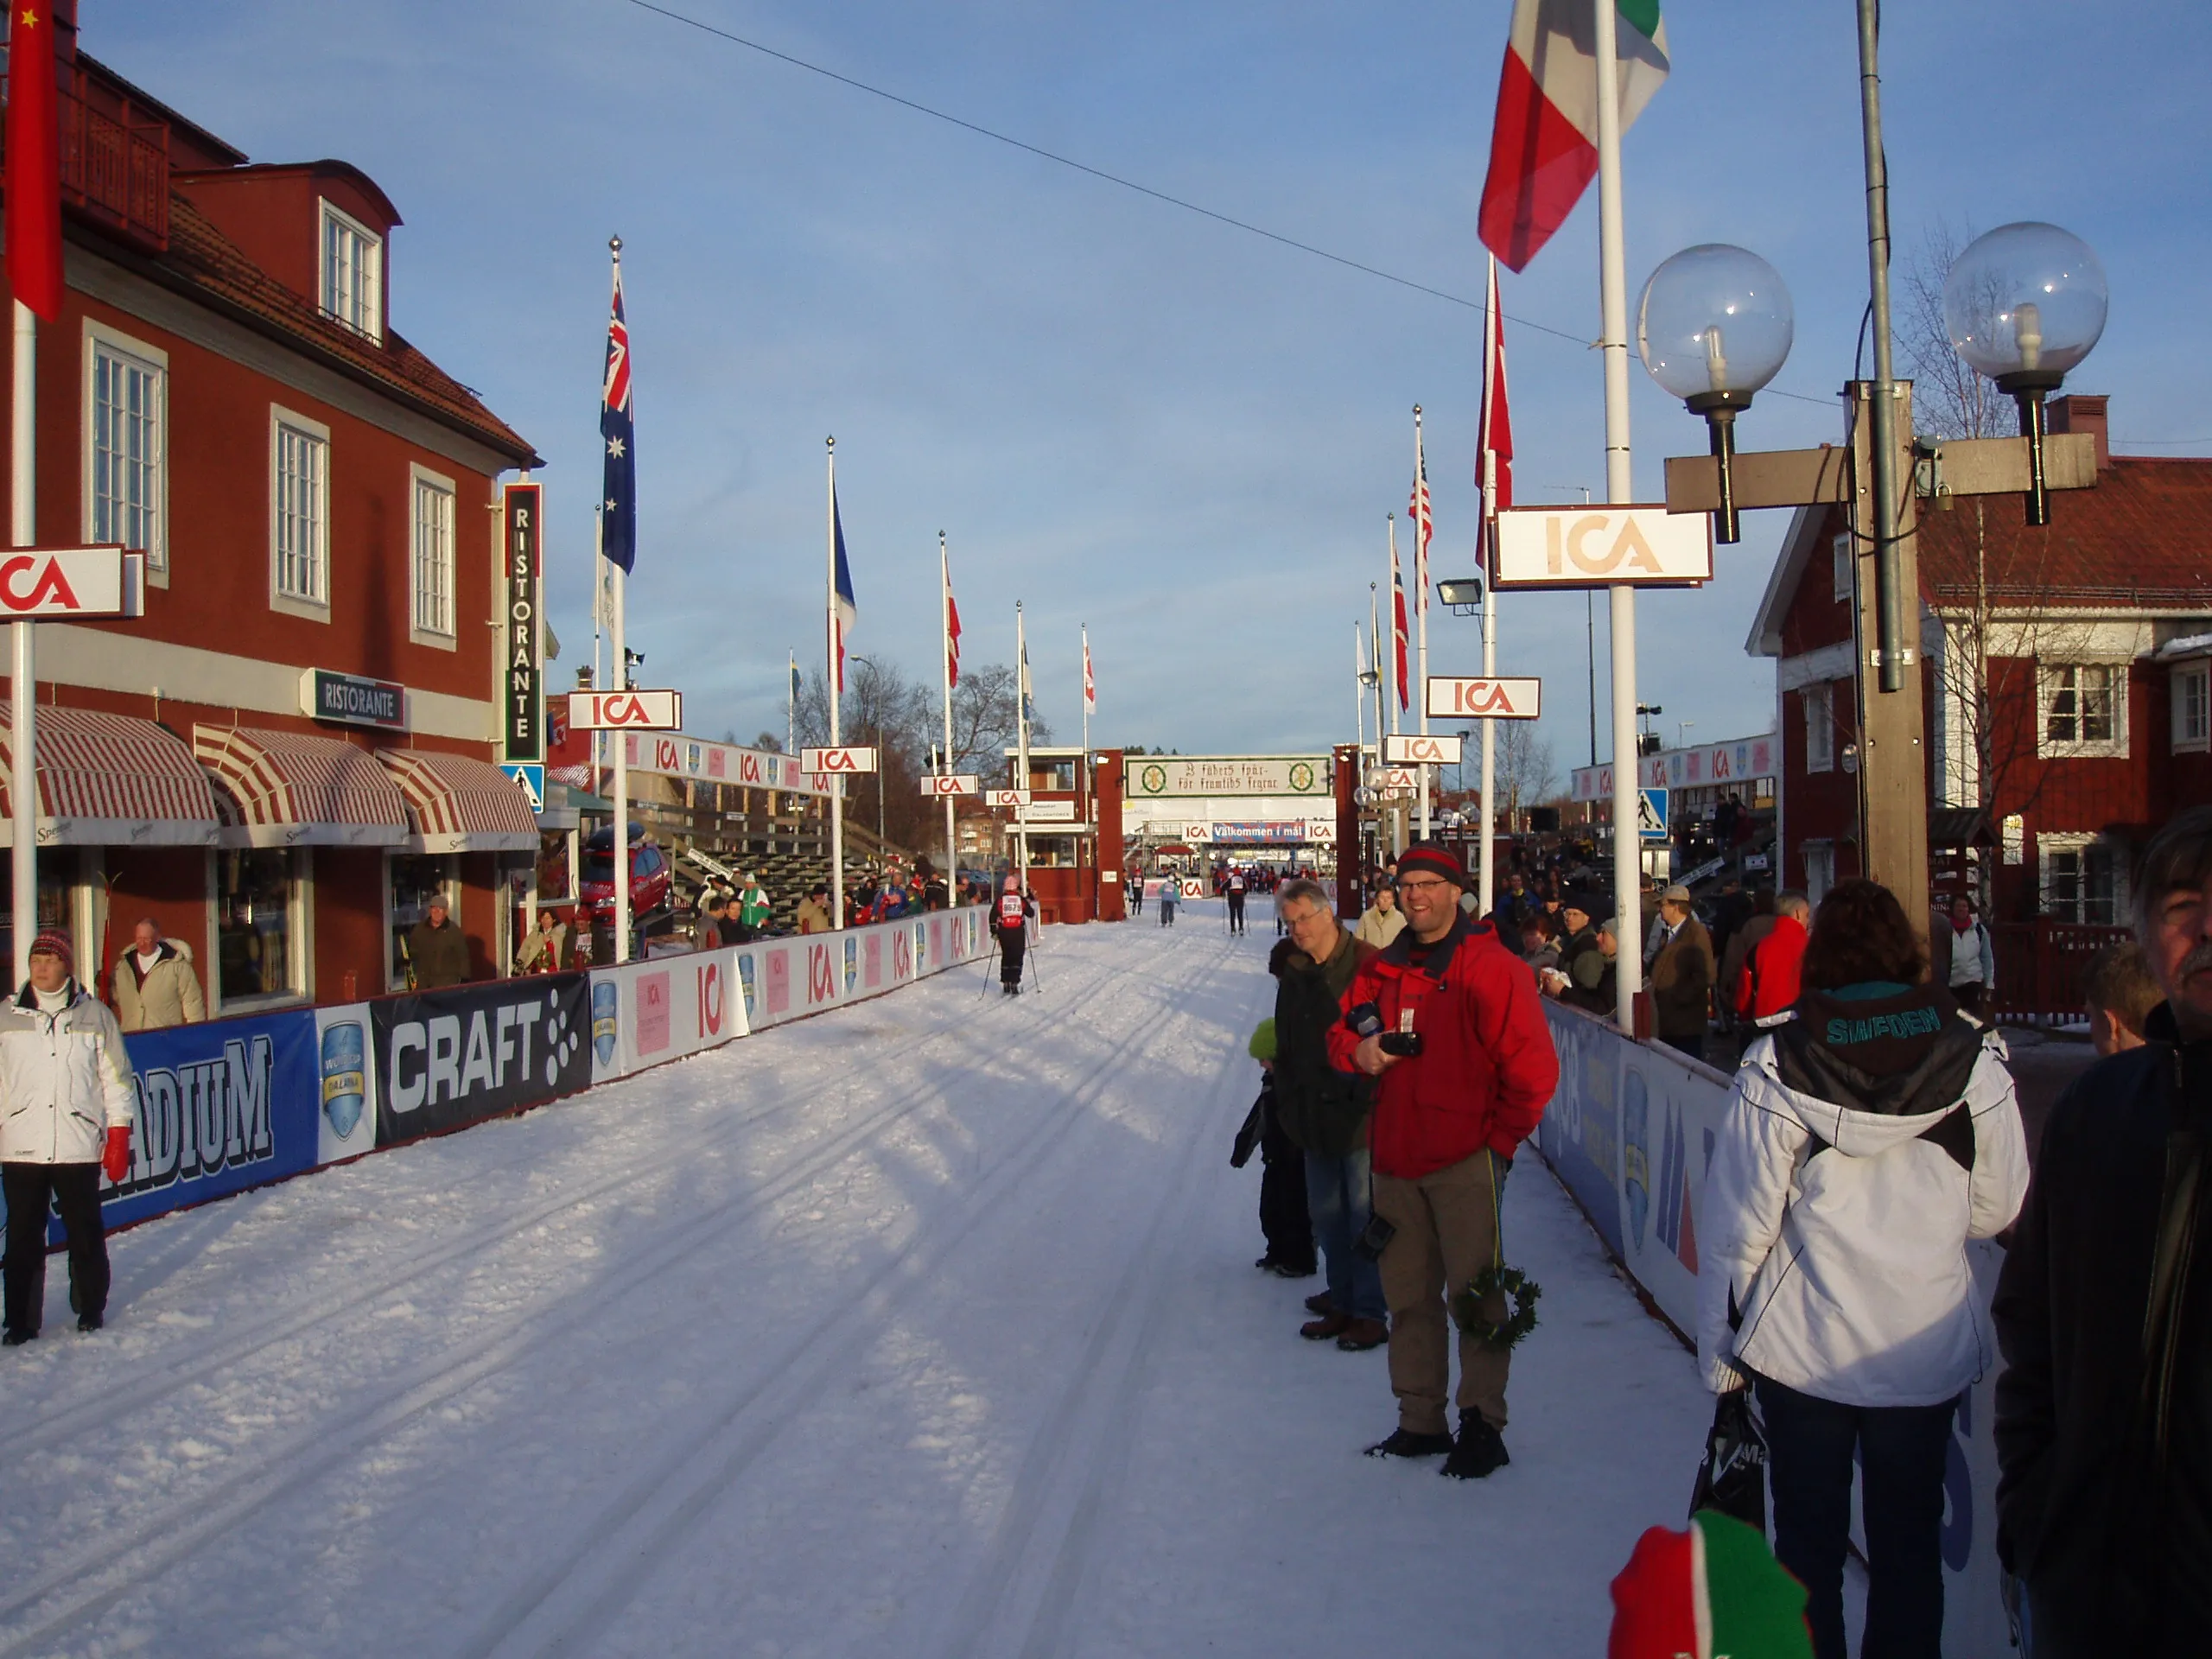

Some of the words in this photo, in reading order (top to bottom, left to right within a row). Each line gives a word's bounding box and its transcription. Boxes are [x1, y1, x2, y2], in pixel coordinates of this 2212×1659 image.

[1546, 515, 1664, 575] ICA
[0, 555, 81, 612] CA
[512, 508, 531, 738] RISTORANTE
[325, 682, 394, 717] RISTORANTE
[592, 695, 651, 725] ICA
[1454, 682, 1515, 714] ICA
[655, 739, 680, 772] ICA
[817, 750, 857, 772] ICA
[1404, 739, 1444, 760] ICA
[1712, 749, 1730, 779] ICA
[740, 753, 760, 784] ICA
[1389, 770, 1413, 786] CA
[1599, 770, 1613, 795] ICA
[1651, 759, 1668, 787] ICA
[932, 778, 963, 793] ICA
[996, 791, 1020, 804] ICA
[1186, 826, 1208, 838] ICA
[1214, 825, 1273, 837] Välkommen
[1283, 825, 1302, 836] mål
[1310, 825, 1332, 838] ICA
[1179, 881, 1203, 897] ICA
[950, 916, 964, 960] ICA
[893, 929, 910, 981] ICA
[808, 944, 835, 1004] ICA
[1827, 1006, 1942, 1045] SWEDEN
[389, 1001, 541, 1114] CRAFT
[99, 1037, 273, 1195] ADIUM
